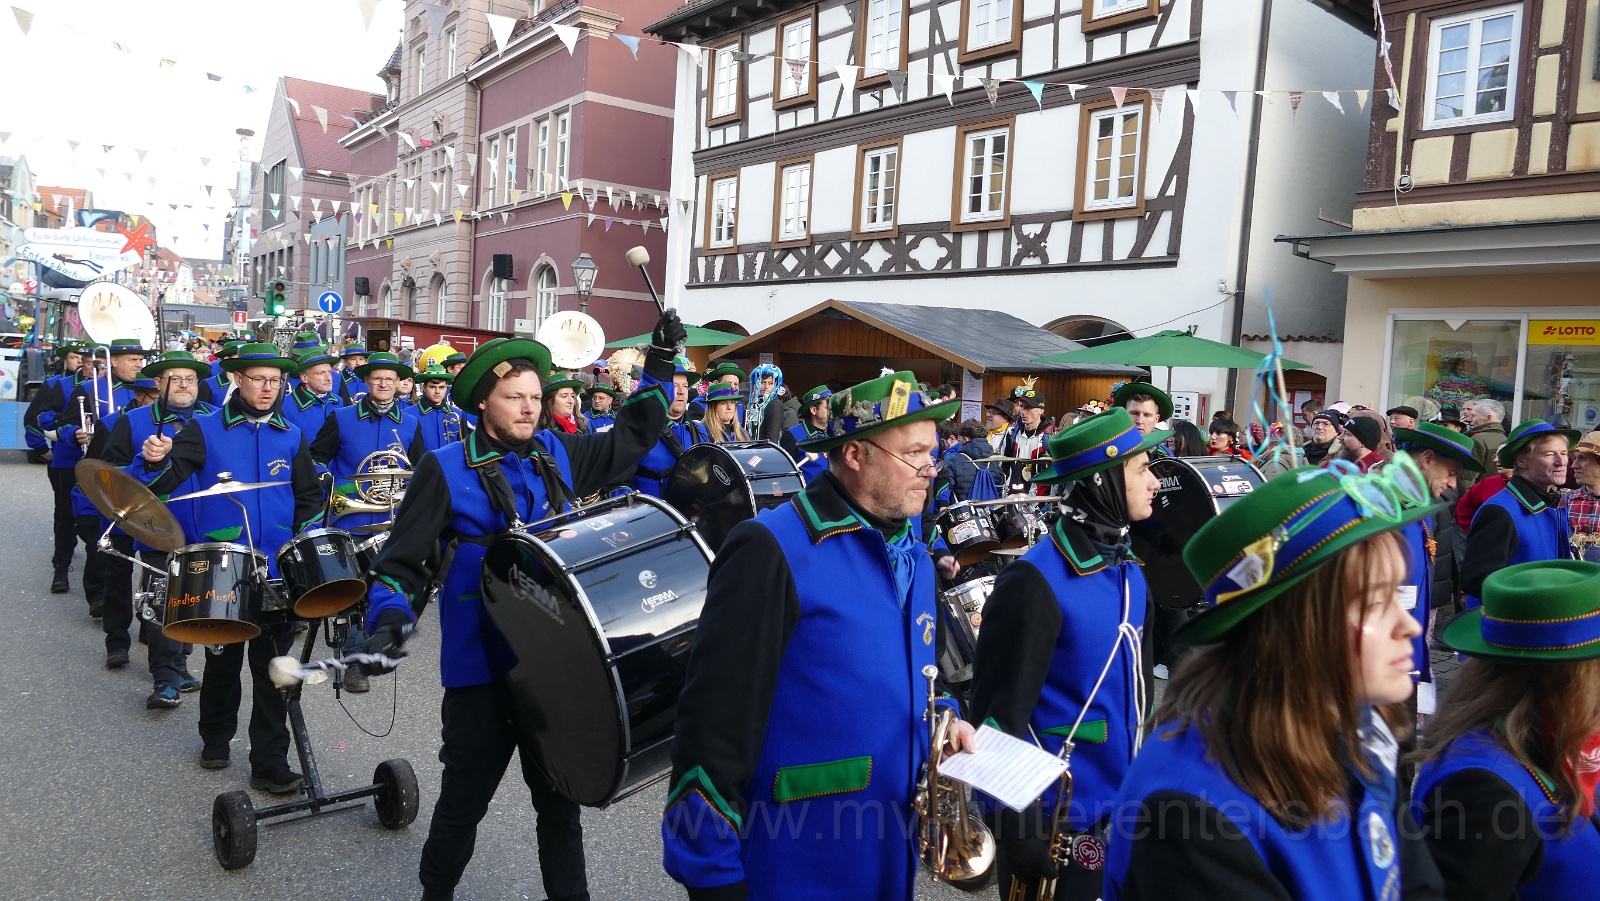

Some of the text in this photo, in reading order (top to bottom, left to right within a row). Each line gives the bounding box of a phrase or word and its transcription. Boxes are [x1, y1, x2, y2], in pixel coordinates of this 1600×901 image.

[22, 246, 78, 279] Entersbach
[1558, 326, 1596, 336] LOTTO
[205, 589, 237, 604] Musik
